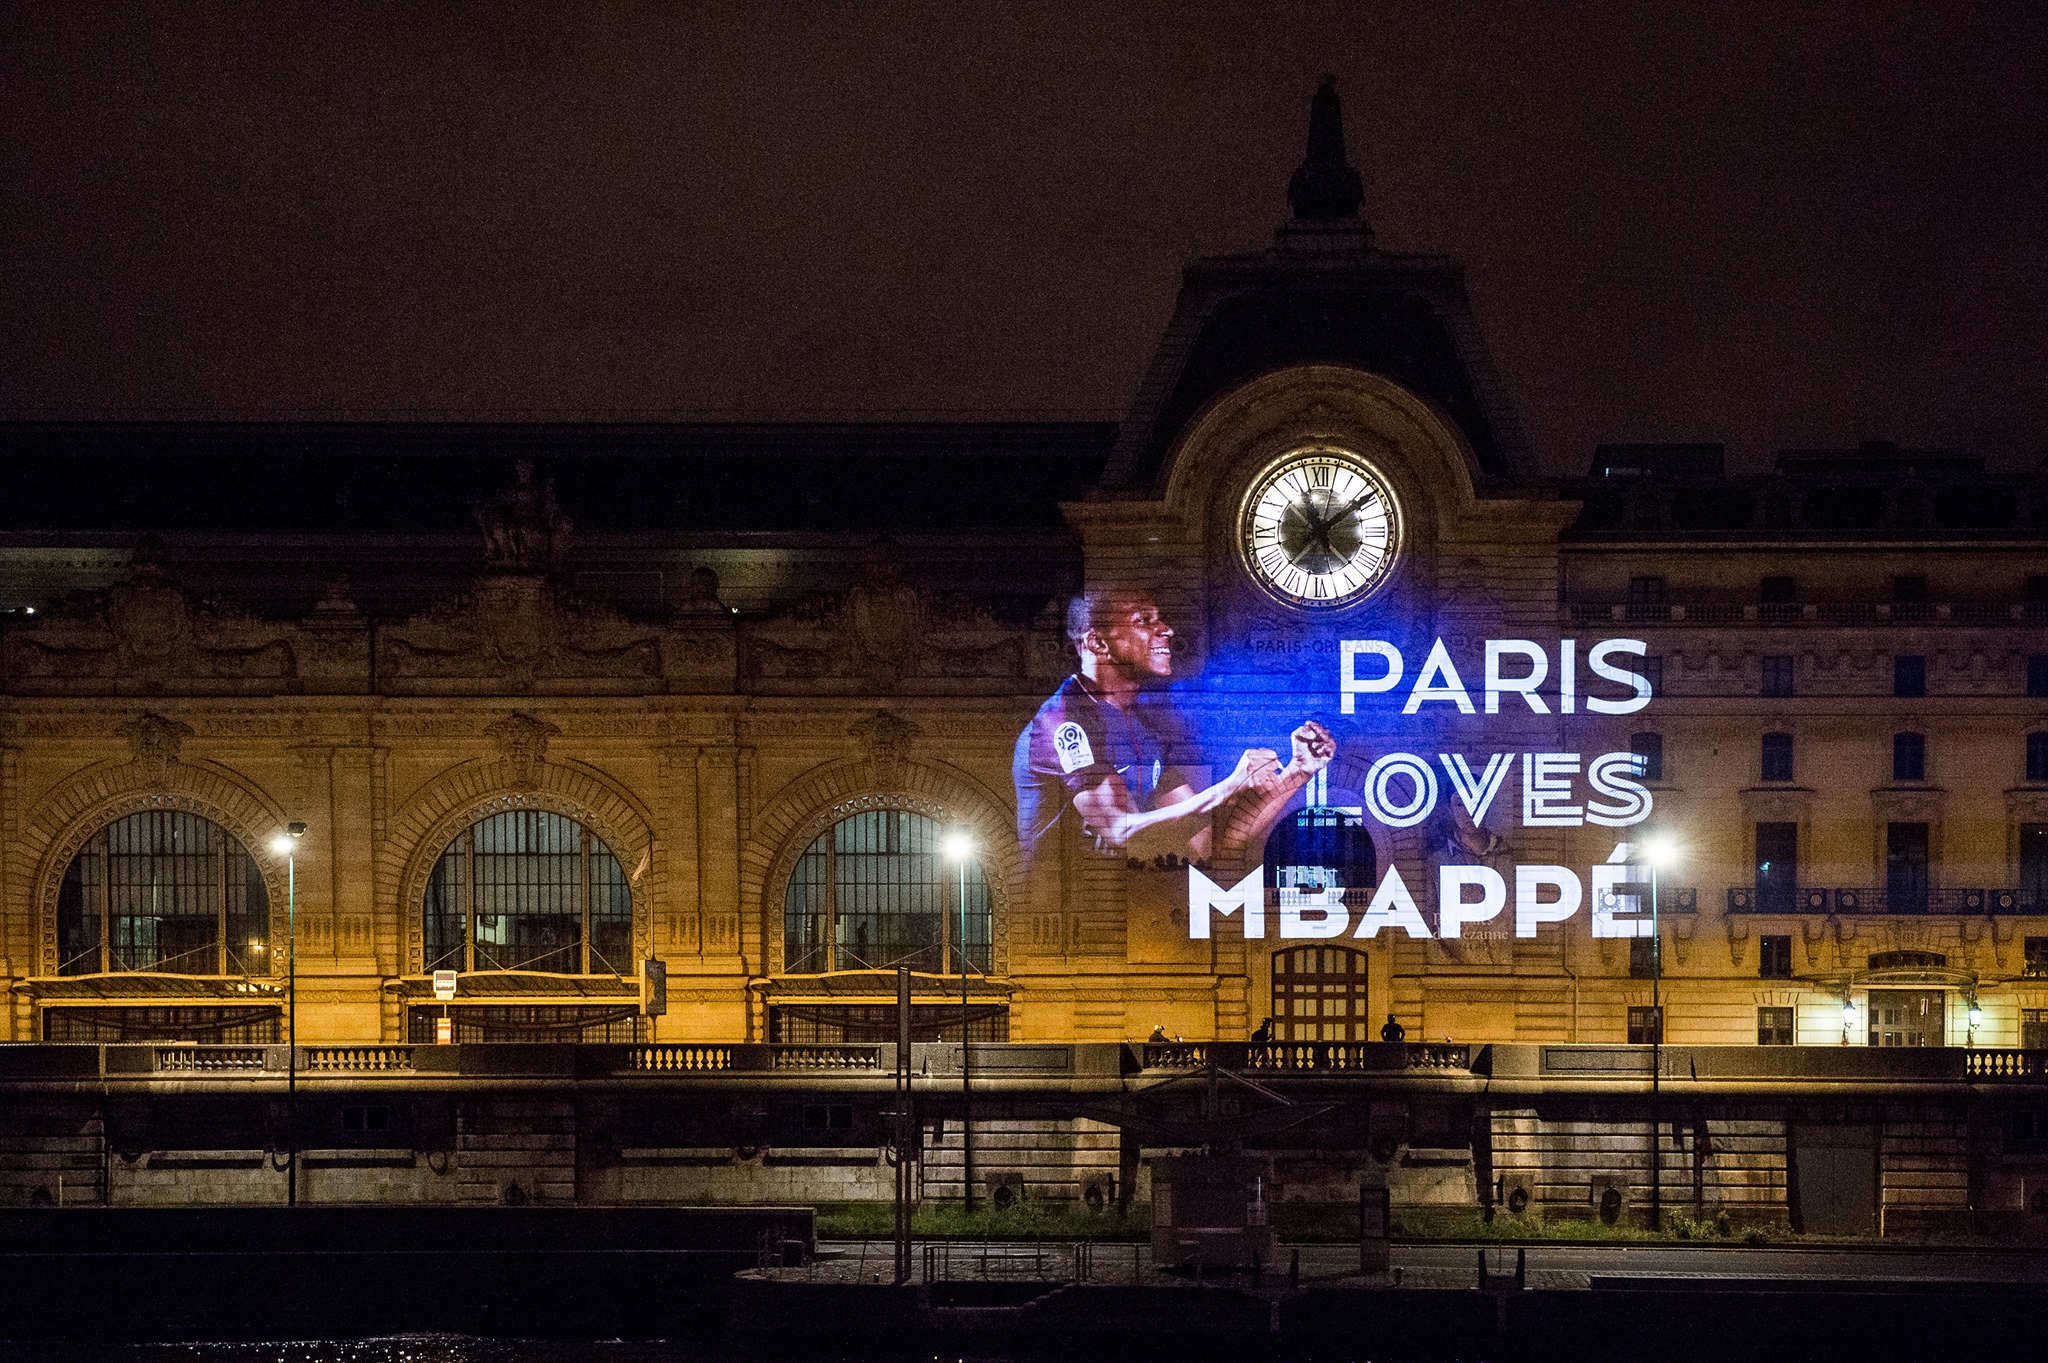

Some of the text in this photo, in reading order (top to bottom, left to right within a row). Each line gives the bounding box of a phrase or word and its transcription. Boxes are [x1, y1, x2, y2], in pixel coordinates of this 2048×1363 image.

[1311, 466, 1329, 487] XII
[1365, 526, 1385, 538] III
[1314, 577, 1328, 598] VI
[1340, 636, 1654, 715] PARIS
[1299, 752, 1654, 827] LOVES
[1188, 843, 1654, 938] MBAPPÉ
